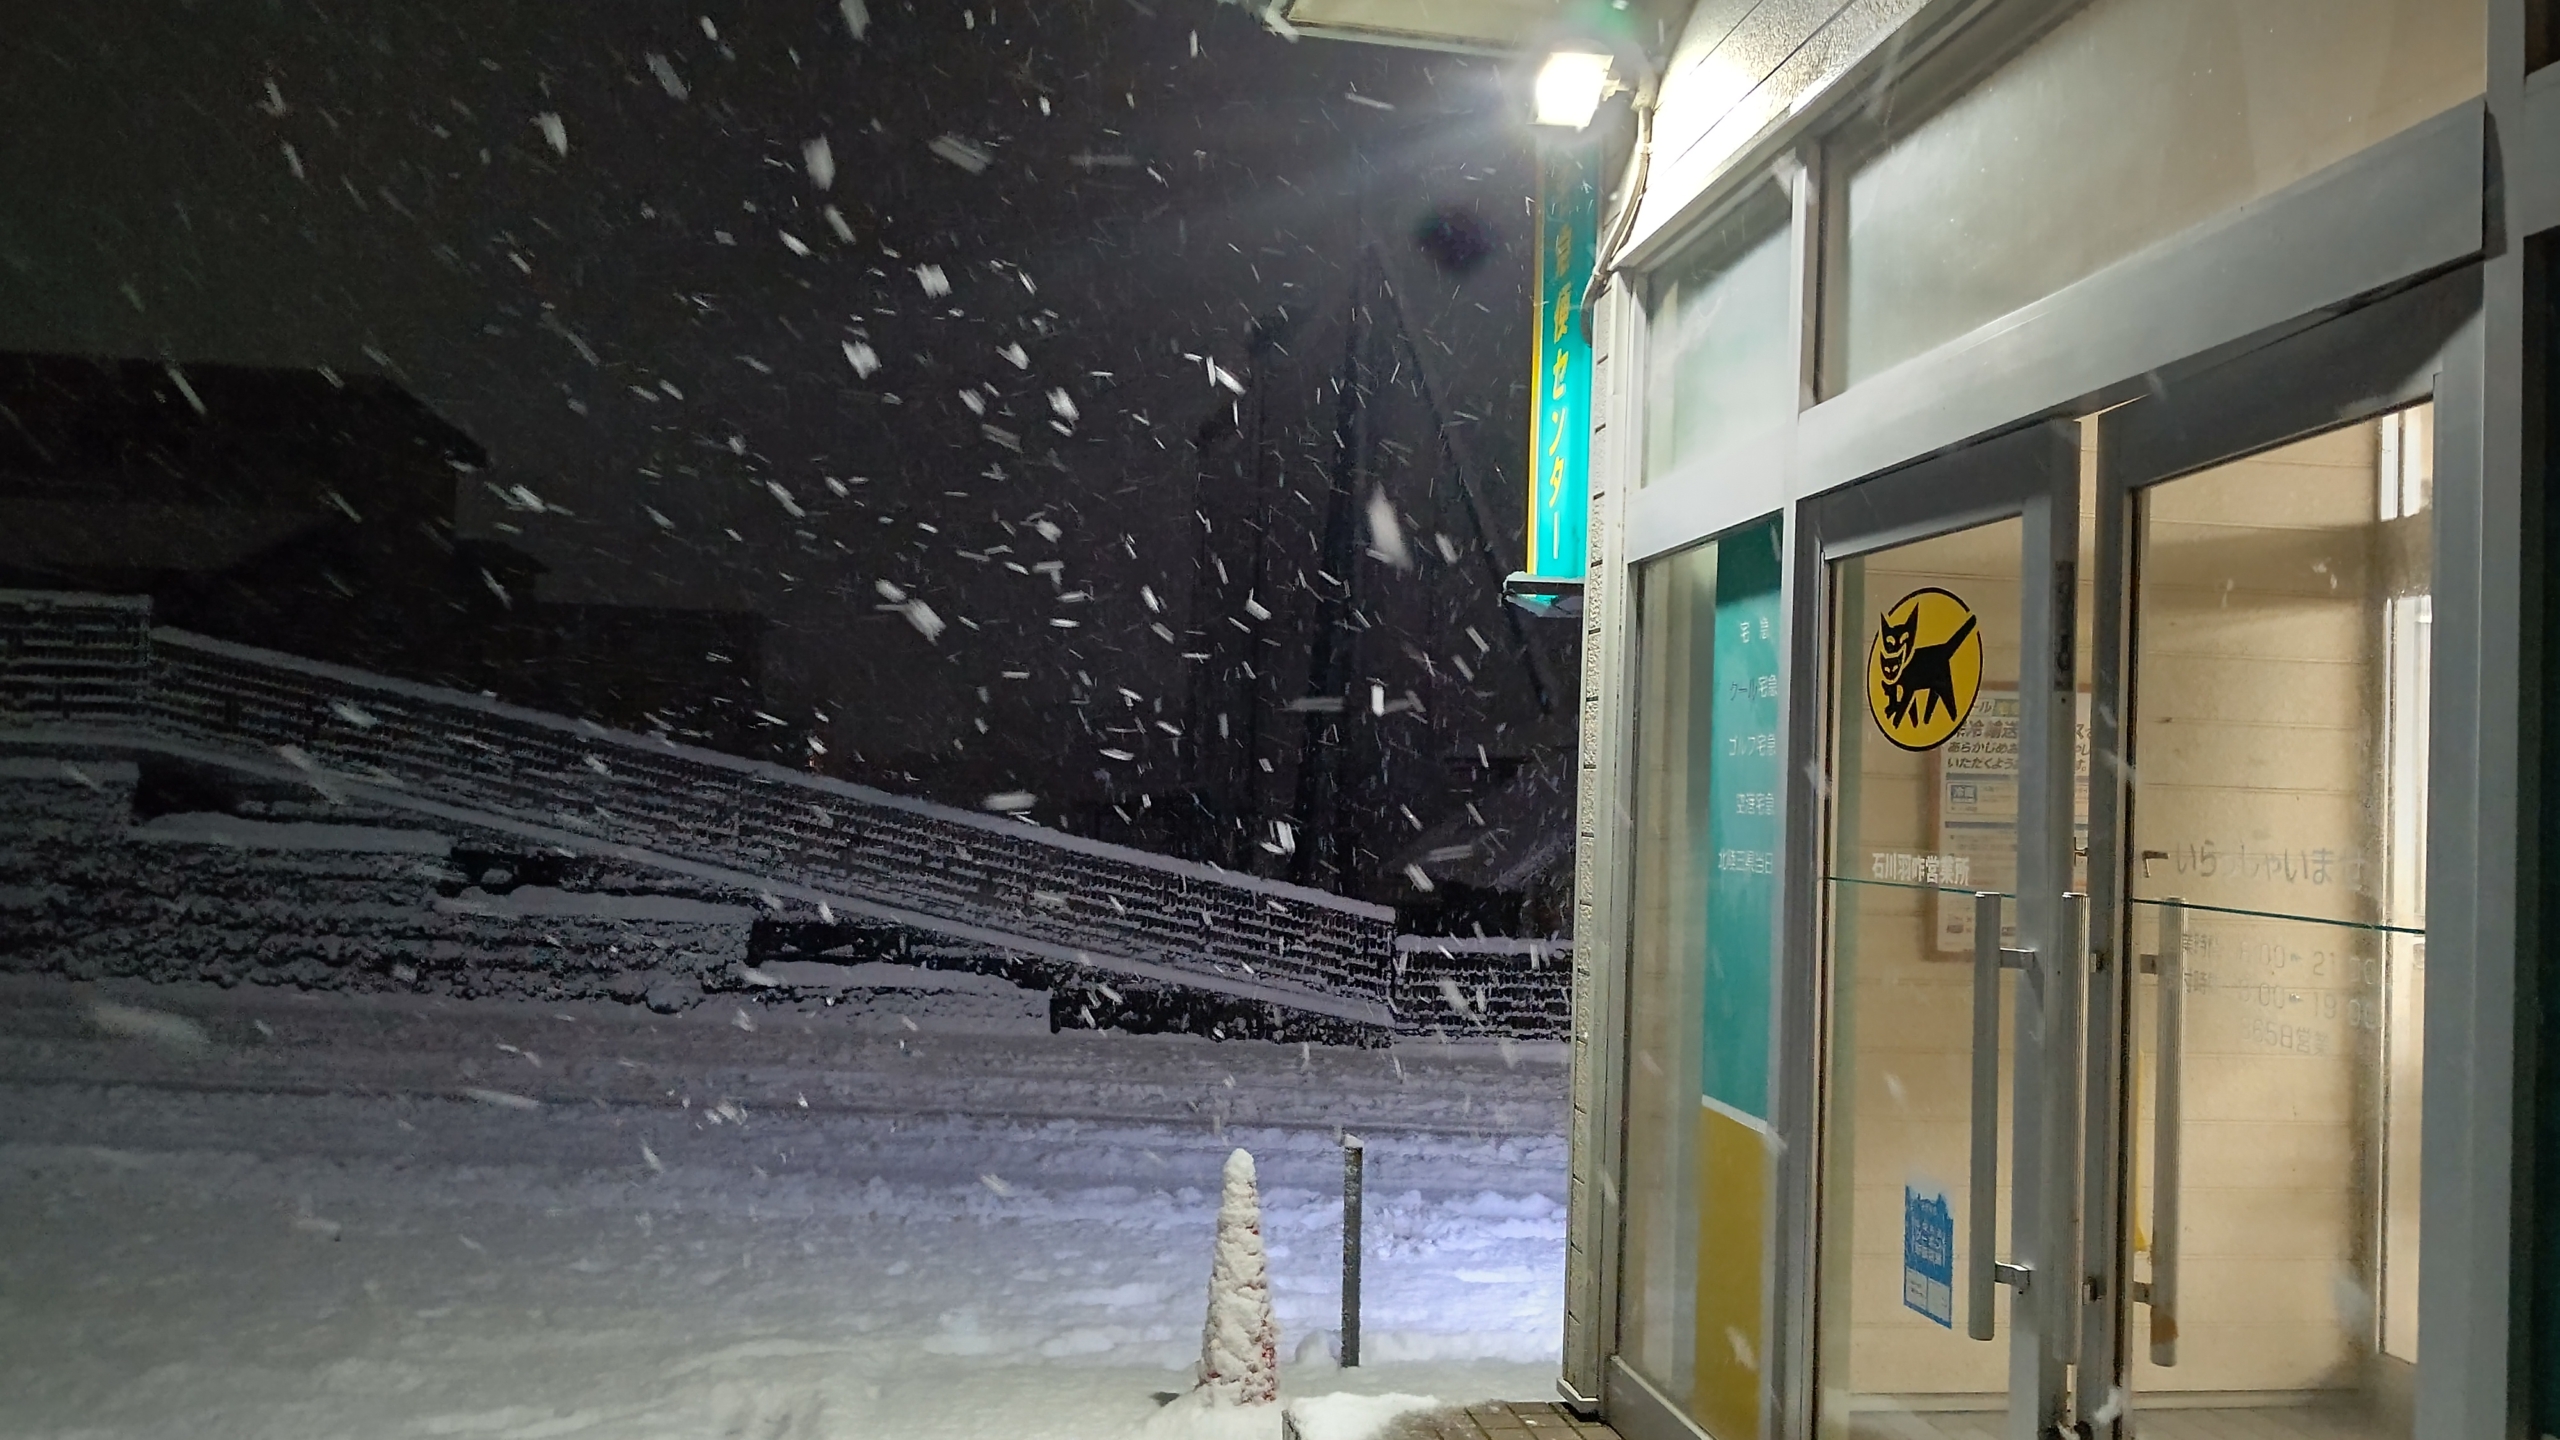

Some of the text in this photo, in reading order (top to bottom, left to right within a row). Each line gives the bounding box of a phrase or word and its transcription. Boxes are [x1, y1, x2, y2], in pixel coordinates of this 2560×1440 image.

[1872, 852, 1970, 886] 石川羽咋営業所
